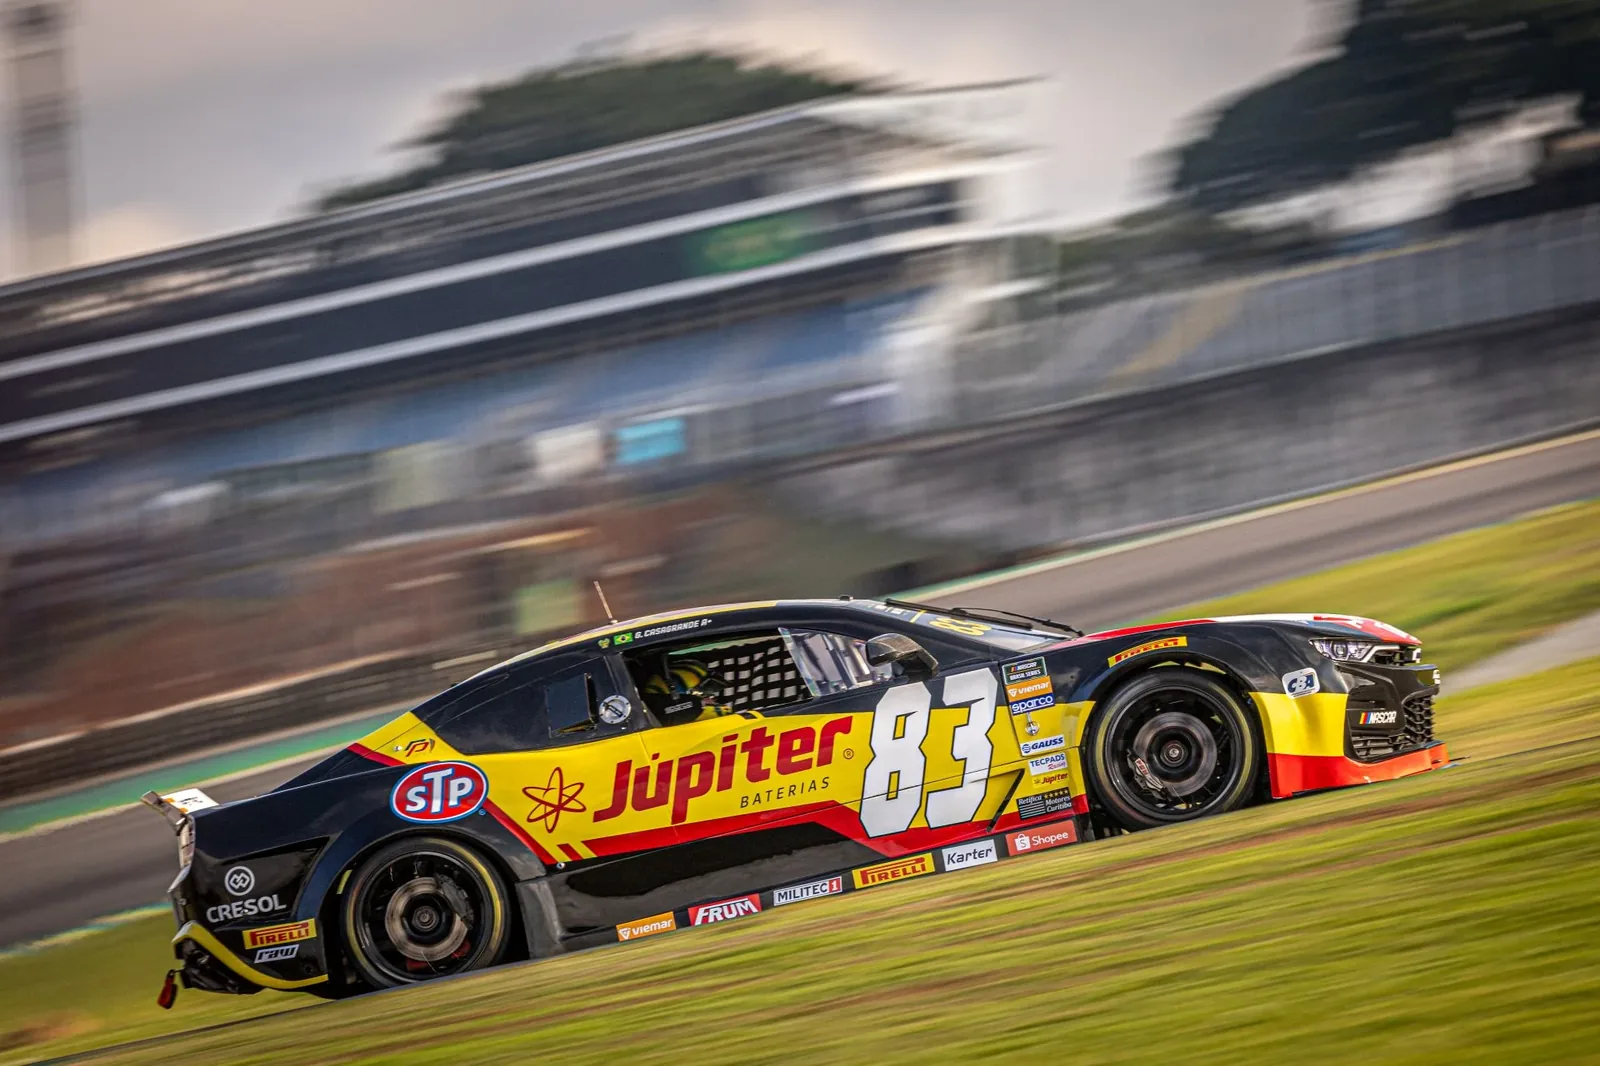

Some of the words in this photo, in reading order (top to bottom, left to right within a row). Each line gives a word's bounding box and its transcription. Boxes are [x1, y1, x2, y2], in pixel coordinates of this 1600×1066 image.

[1115, 638, 1179, 662] PIRELLI
[1018, 682, 1049, 694] viemar
[1287, 673, 1315, 693] CBA
[1011, 695, 1053, 713] sparco
[1369, 710, 1397, 724] NASCAR
[859, 667, 999, 839] 83
[1031, 737, 1064, 750] GAUSS
[1030, 753, 1065, 767] TECPADS
[405, 767, 475, 815] STP
[740, 776, 831, 809] BATERIAS
[1045, 795, 1071, 806] Motores
[1046, 802, 1073, 813] Curitiba
[1032, 832, 1069, 846] Shopee
[947, 846, 993, 866] Karter
[860, 856, 926, 885] PIRELLI
[206, 894, 287, 923] CRESOL
[694, 898, 758, 925] FRUM
[250, 922, 309, 947] PIRELLI
[632, 918, 673, 935] viemar
